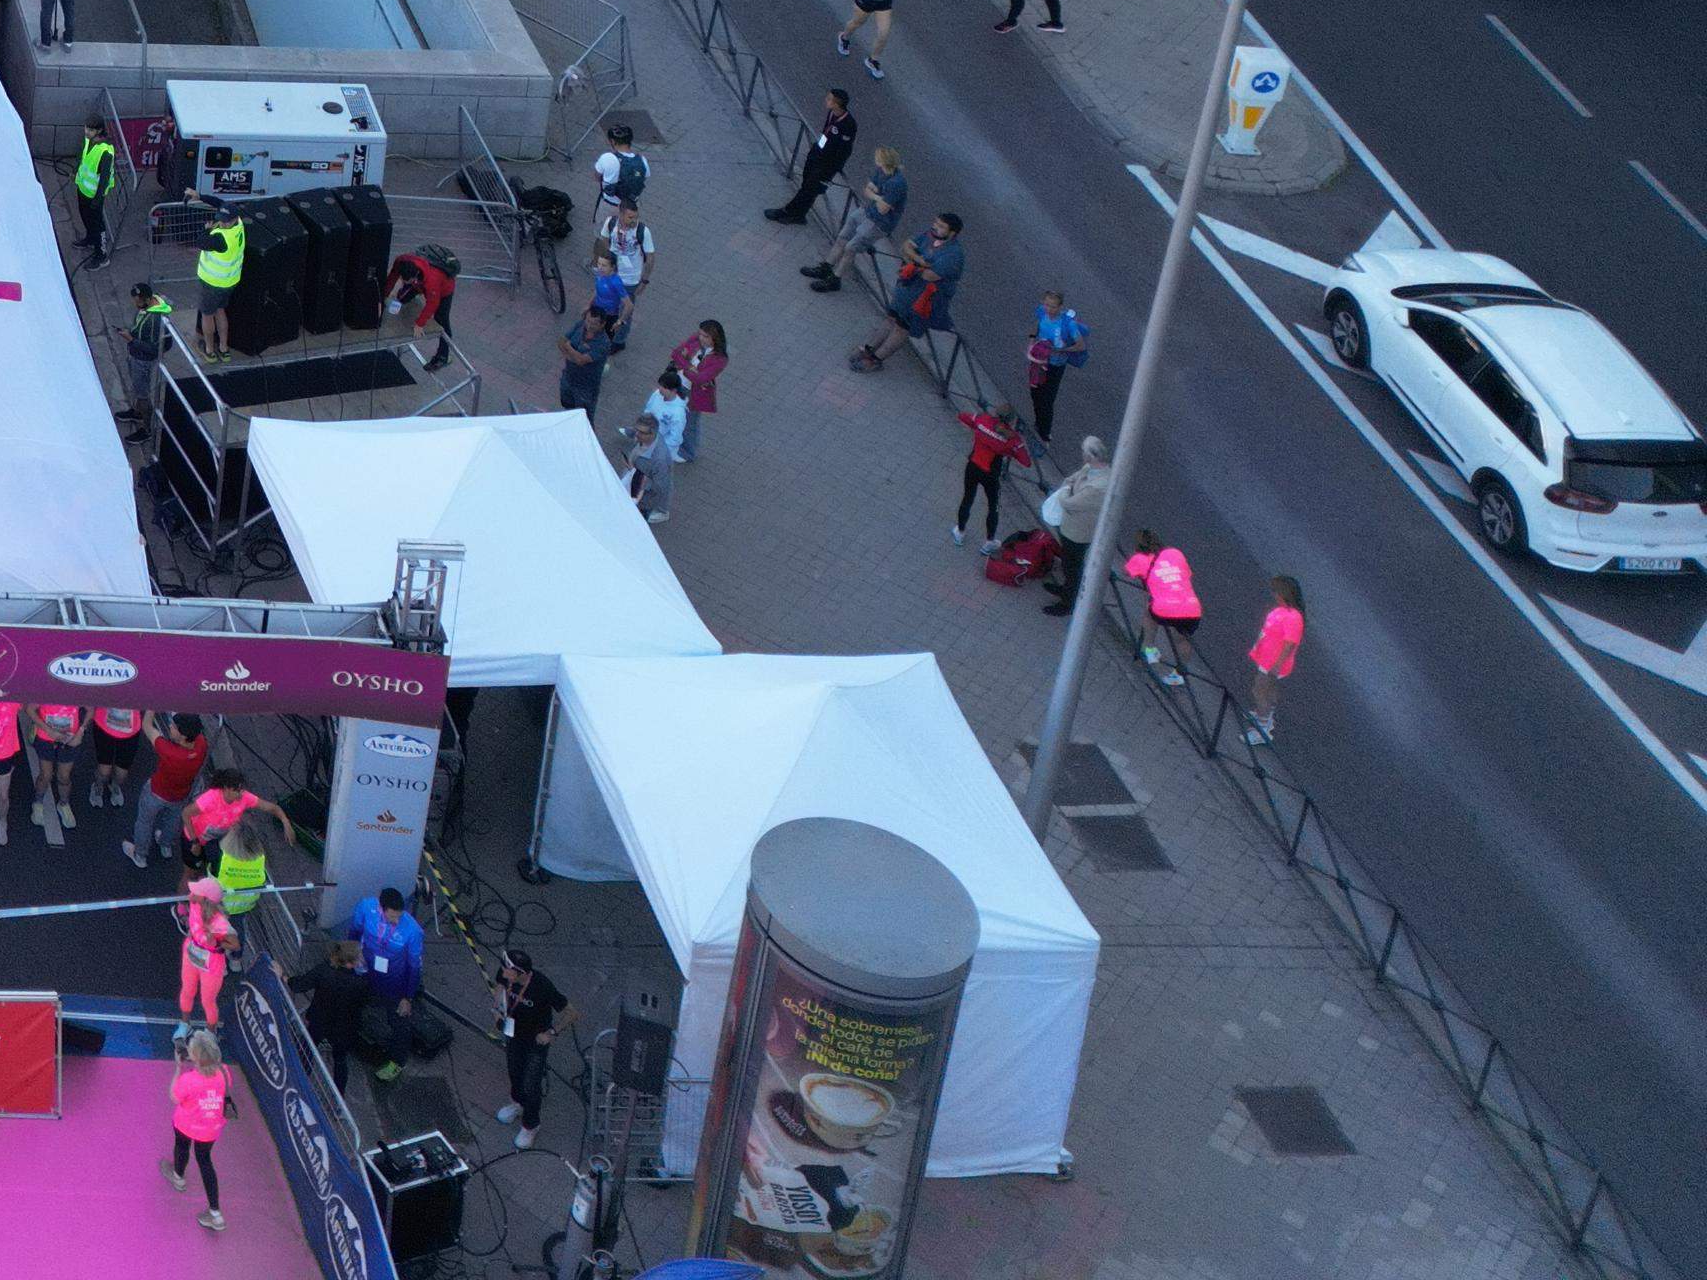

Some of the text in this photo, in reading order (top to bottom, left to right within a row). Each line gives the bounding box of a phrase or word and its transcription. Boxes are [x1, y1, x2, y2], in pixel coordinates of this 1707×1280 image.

[220, 171, 247, 183] AMS
[55, 662, 131, 679] ASTURIANA
[201, 680, 272, 692] Santander
[332, 671, 424, 696] OYSHO
[368, 739, 429, 756] ASTURIANA
[356, 773, 428, 793] OYSHO
[356, 821, 415, 836] Santander
[239, 991, 281, 1080] ASTURIANA
[830, 1023, 873, 1044] todos
[809, 1039, 860, 1065] misma
[873, 1045, 894, 1058] de
[830, 1058, 853, 1073] de
[287, 1098, 329, 1199] ASTURIANA
